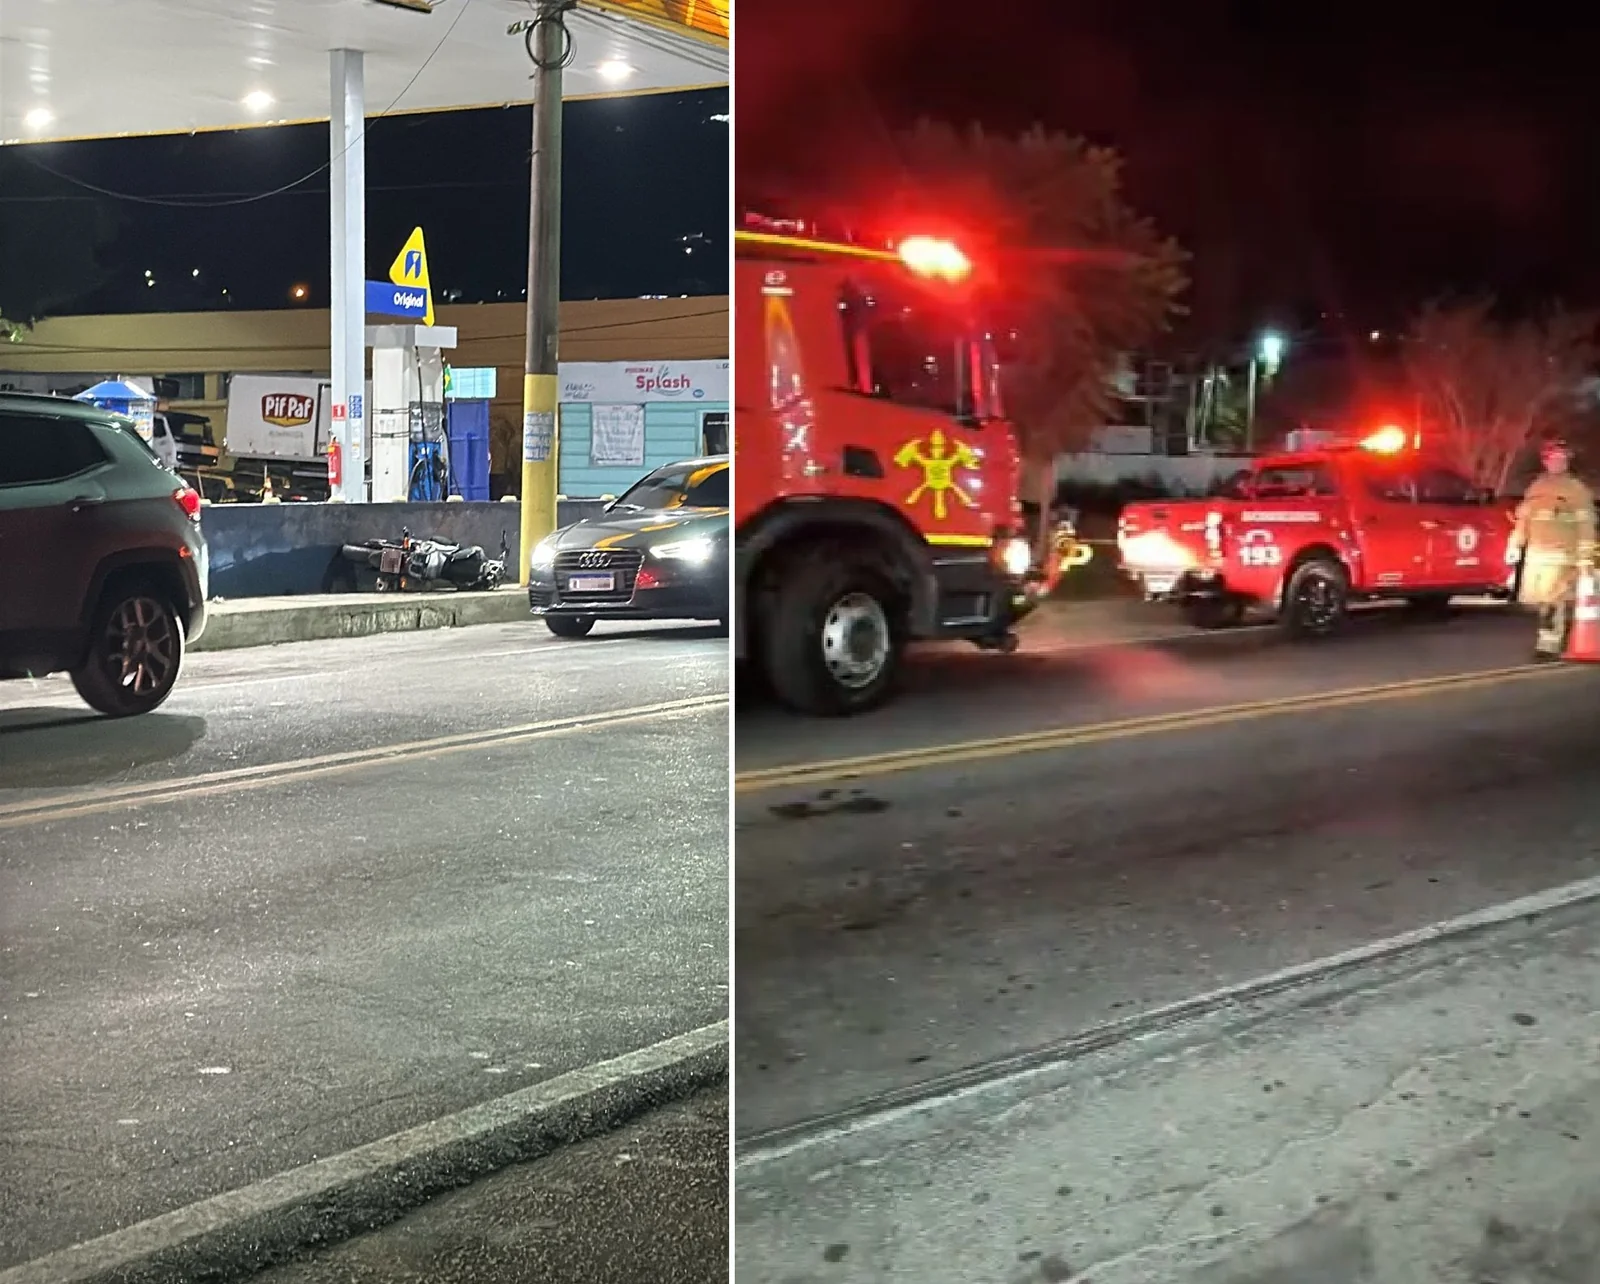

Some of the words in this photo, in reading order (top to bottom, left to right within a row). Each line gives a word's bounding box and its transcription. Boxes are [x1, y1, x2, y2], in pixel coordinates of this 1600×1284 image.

[393, 292, 423, 309] Original
[636, 374, 691, 392] Splash
[265, 396, 286, 417] Pif
[287, 397, 312, 418] Paf
[1239, 546, 1282, 566] 193
